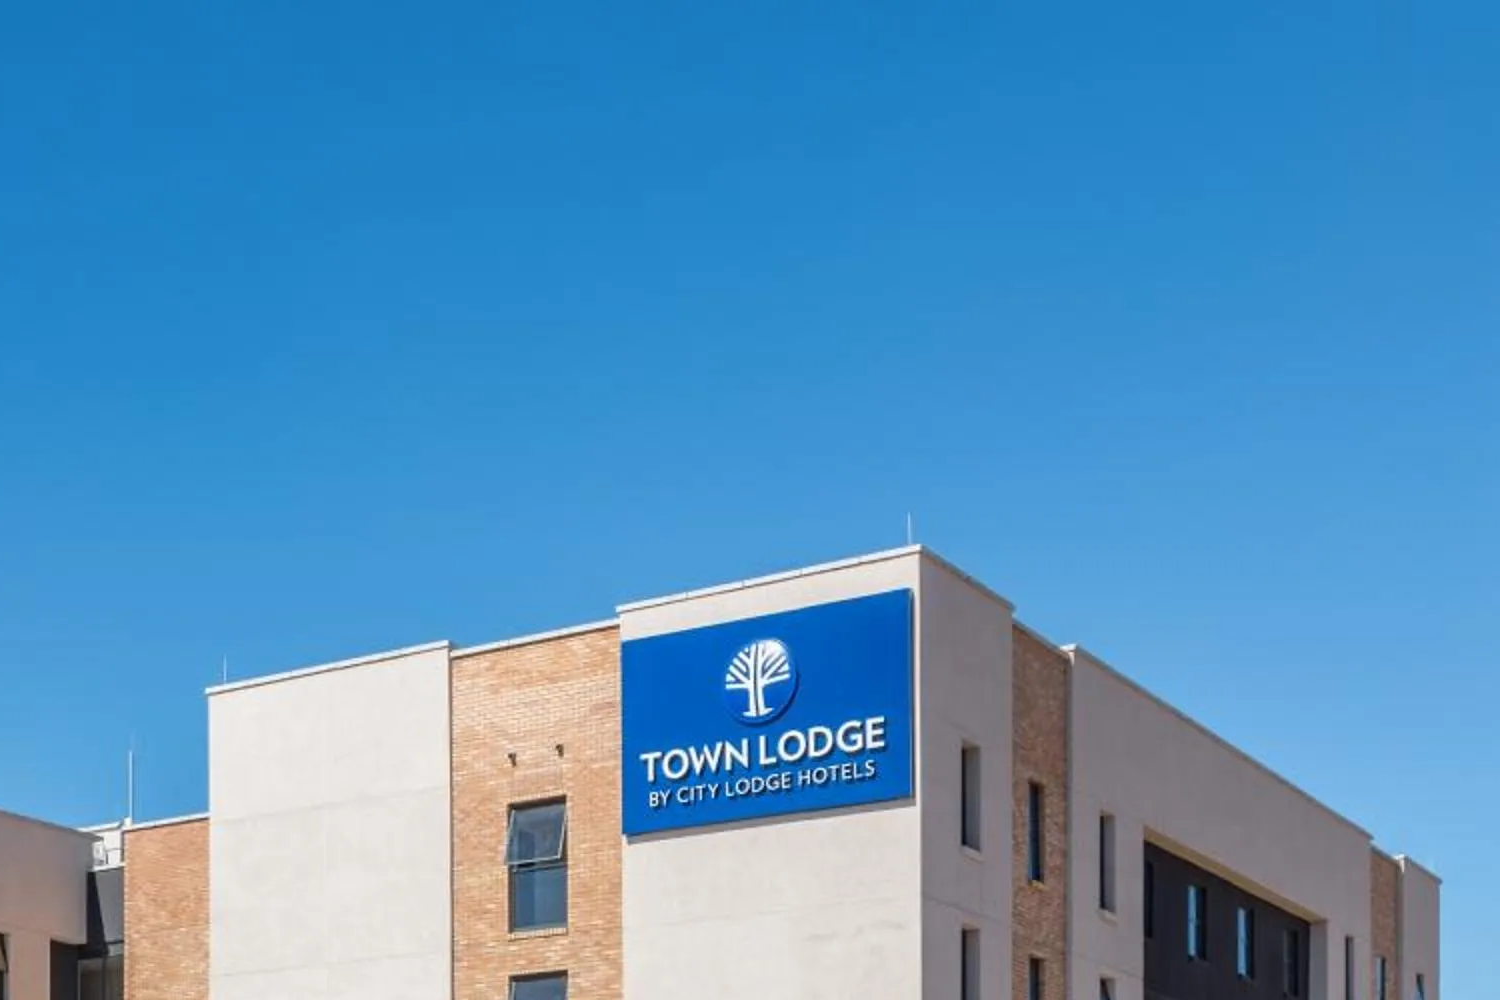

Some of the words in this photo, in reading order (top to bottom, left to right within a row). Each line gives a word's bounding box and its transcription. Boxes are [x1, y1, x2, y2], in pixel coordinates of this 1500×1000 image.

[639, 737, 749, 782] TOWN
[759, 716, 885, 765] LODGE
[649, 789, 671, 808] BY
[677, 783, 719, 803] CITY
[725, 771, 791, 797] LODGE
[798, 759, 875, 786] HOTELS
